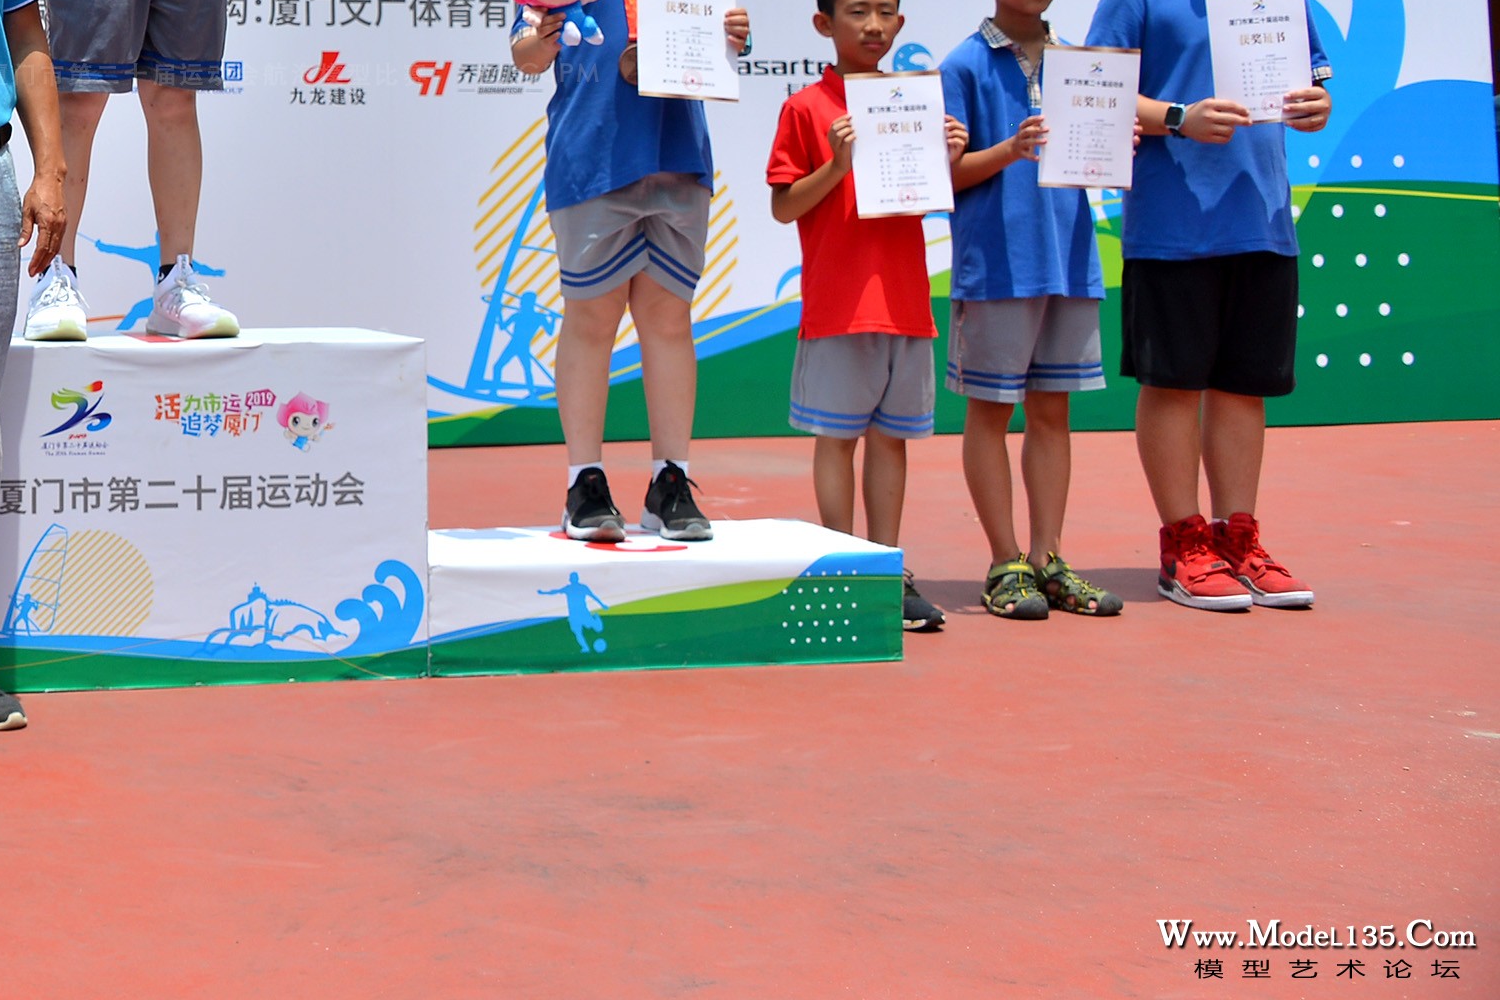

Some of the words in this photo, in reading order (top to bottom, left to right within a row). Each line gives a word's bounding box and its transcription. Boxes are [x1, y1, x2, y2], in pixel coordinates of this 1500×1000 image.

[289, 87, 366, 106] 九龙建设
[154, 392, 243, 425] 活力市运
[247, 391, 274, 408] 2019
[180, 411, 263, 438] 追梦厦门
